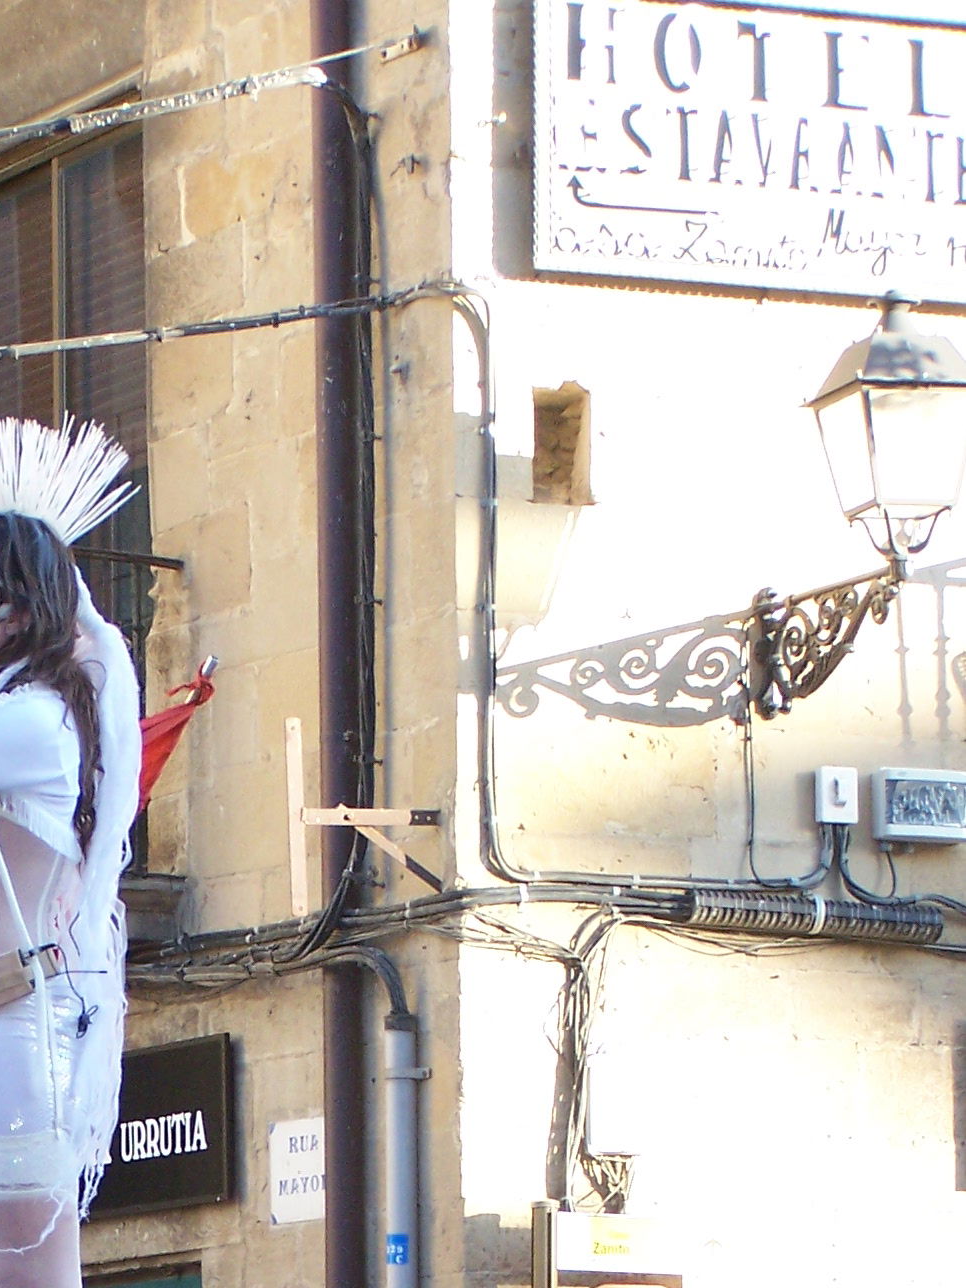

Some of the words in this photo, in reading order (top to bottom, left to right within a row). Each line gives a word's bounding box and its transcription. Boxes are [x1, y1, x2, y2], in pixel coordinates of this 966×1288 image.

[565, 1, 952, 119] HOTEL
[120, 1110, 208, 1162] URRUTIA
[288, 1134, 319, 1154] RUA
